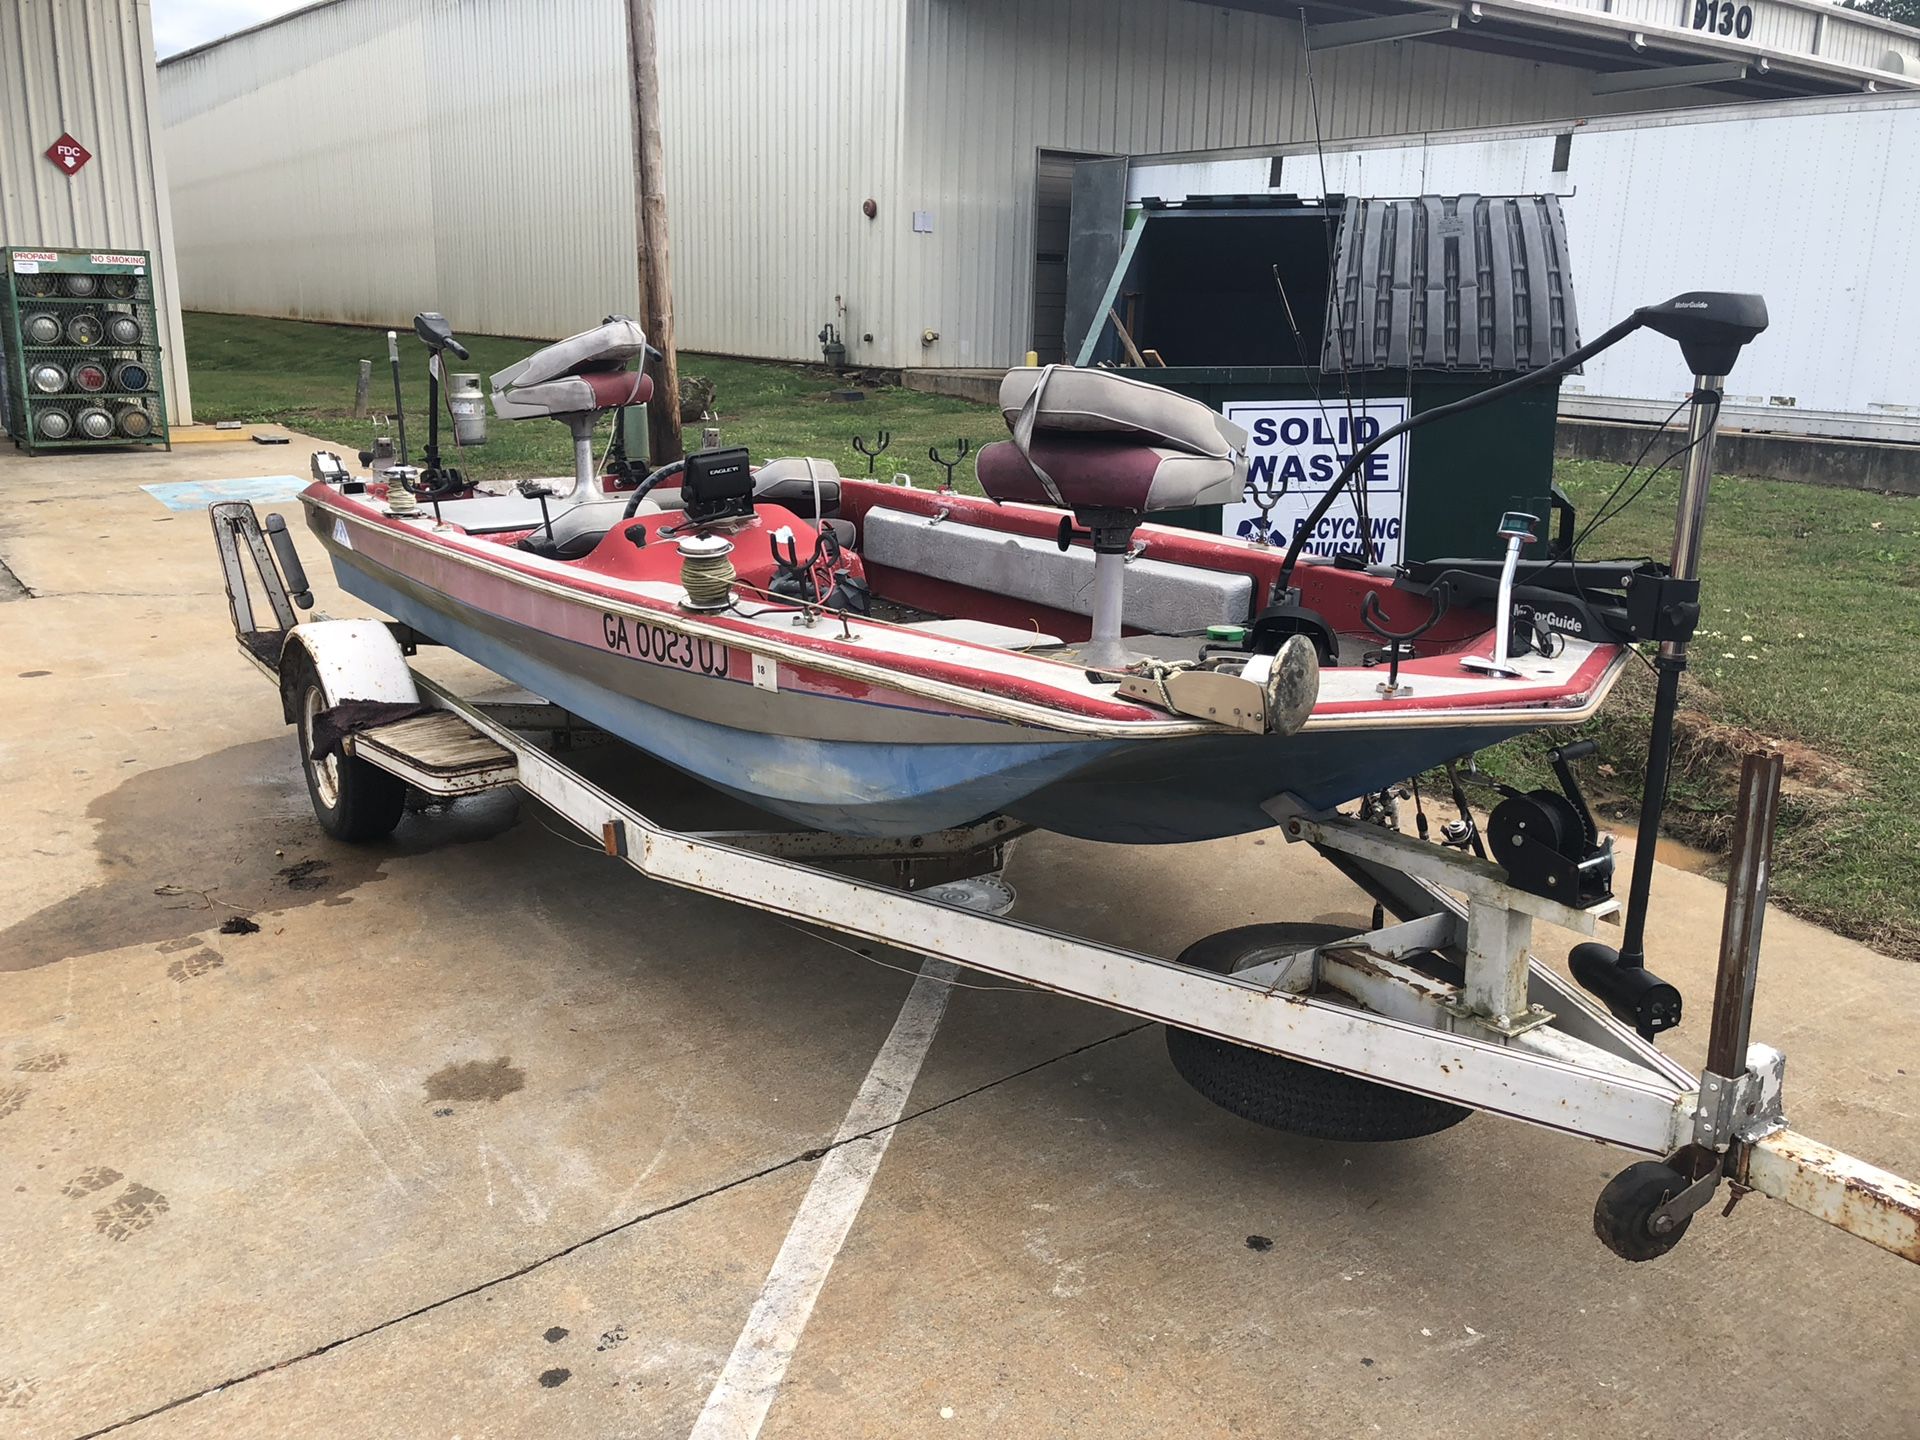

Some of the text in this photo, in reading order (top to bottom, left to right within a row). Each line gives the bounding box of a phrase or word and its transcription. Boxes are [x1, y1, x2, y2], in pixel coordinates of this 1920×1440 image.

[57, 145, 80, 157] FDC
[14, 252, 56, 261] PROPANE
[91, 255, 145, 265] NO SMOKING
[1253, 416, 1380, 446] SOLID
[1292, 517, 1400, 540] RCYCLNG
[1513, 603, 1582, 632] MorGuide
[603, 613, 729, 677] GA 0023 UJ
[757, 664, 766, 675] 18
